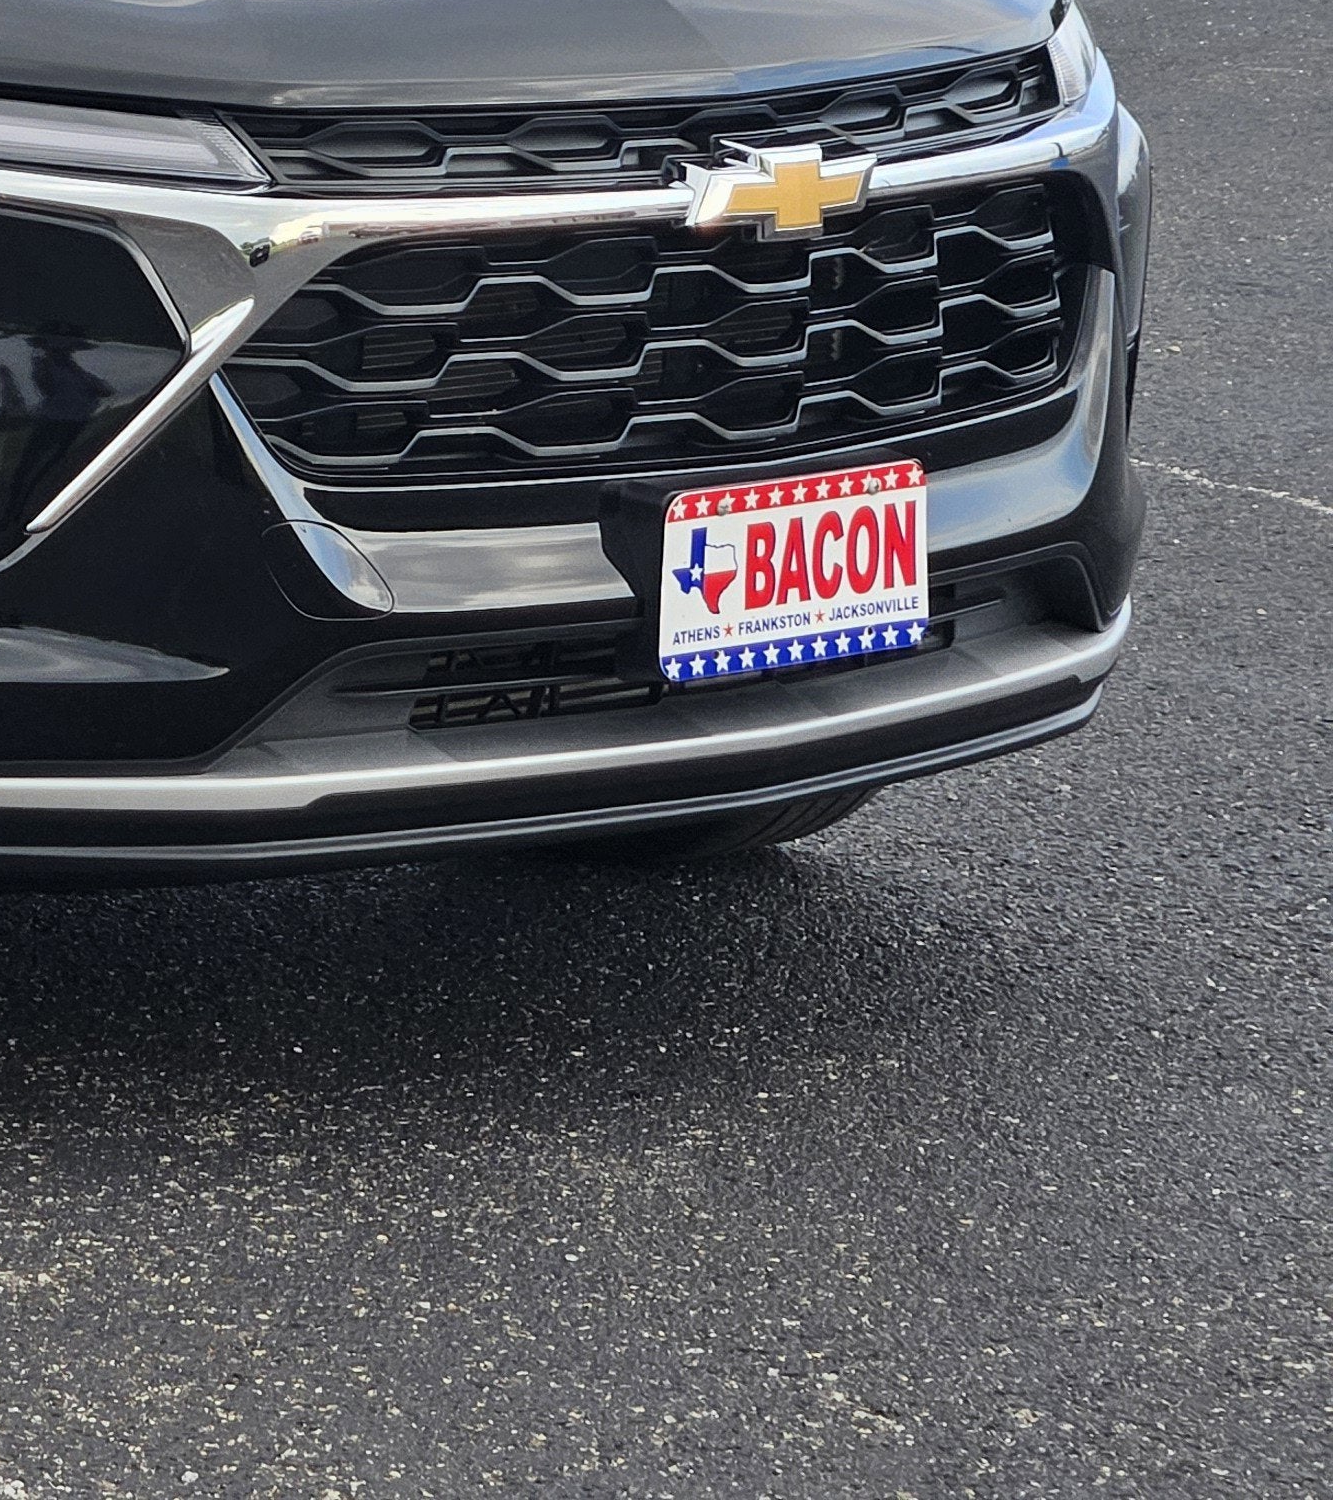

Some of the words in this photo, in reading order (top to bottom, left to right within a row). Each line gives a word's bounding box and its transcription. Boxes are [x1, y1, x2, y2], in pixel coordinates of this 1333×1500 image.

[744, 500, 917, 610] BACON
[672, 625, 721, 646] ATHENS
[738, 611, 811, 637] FRANKSTON
[828, 596, 919, 622] JACKSONVILLE
